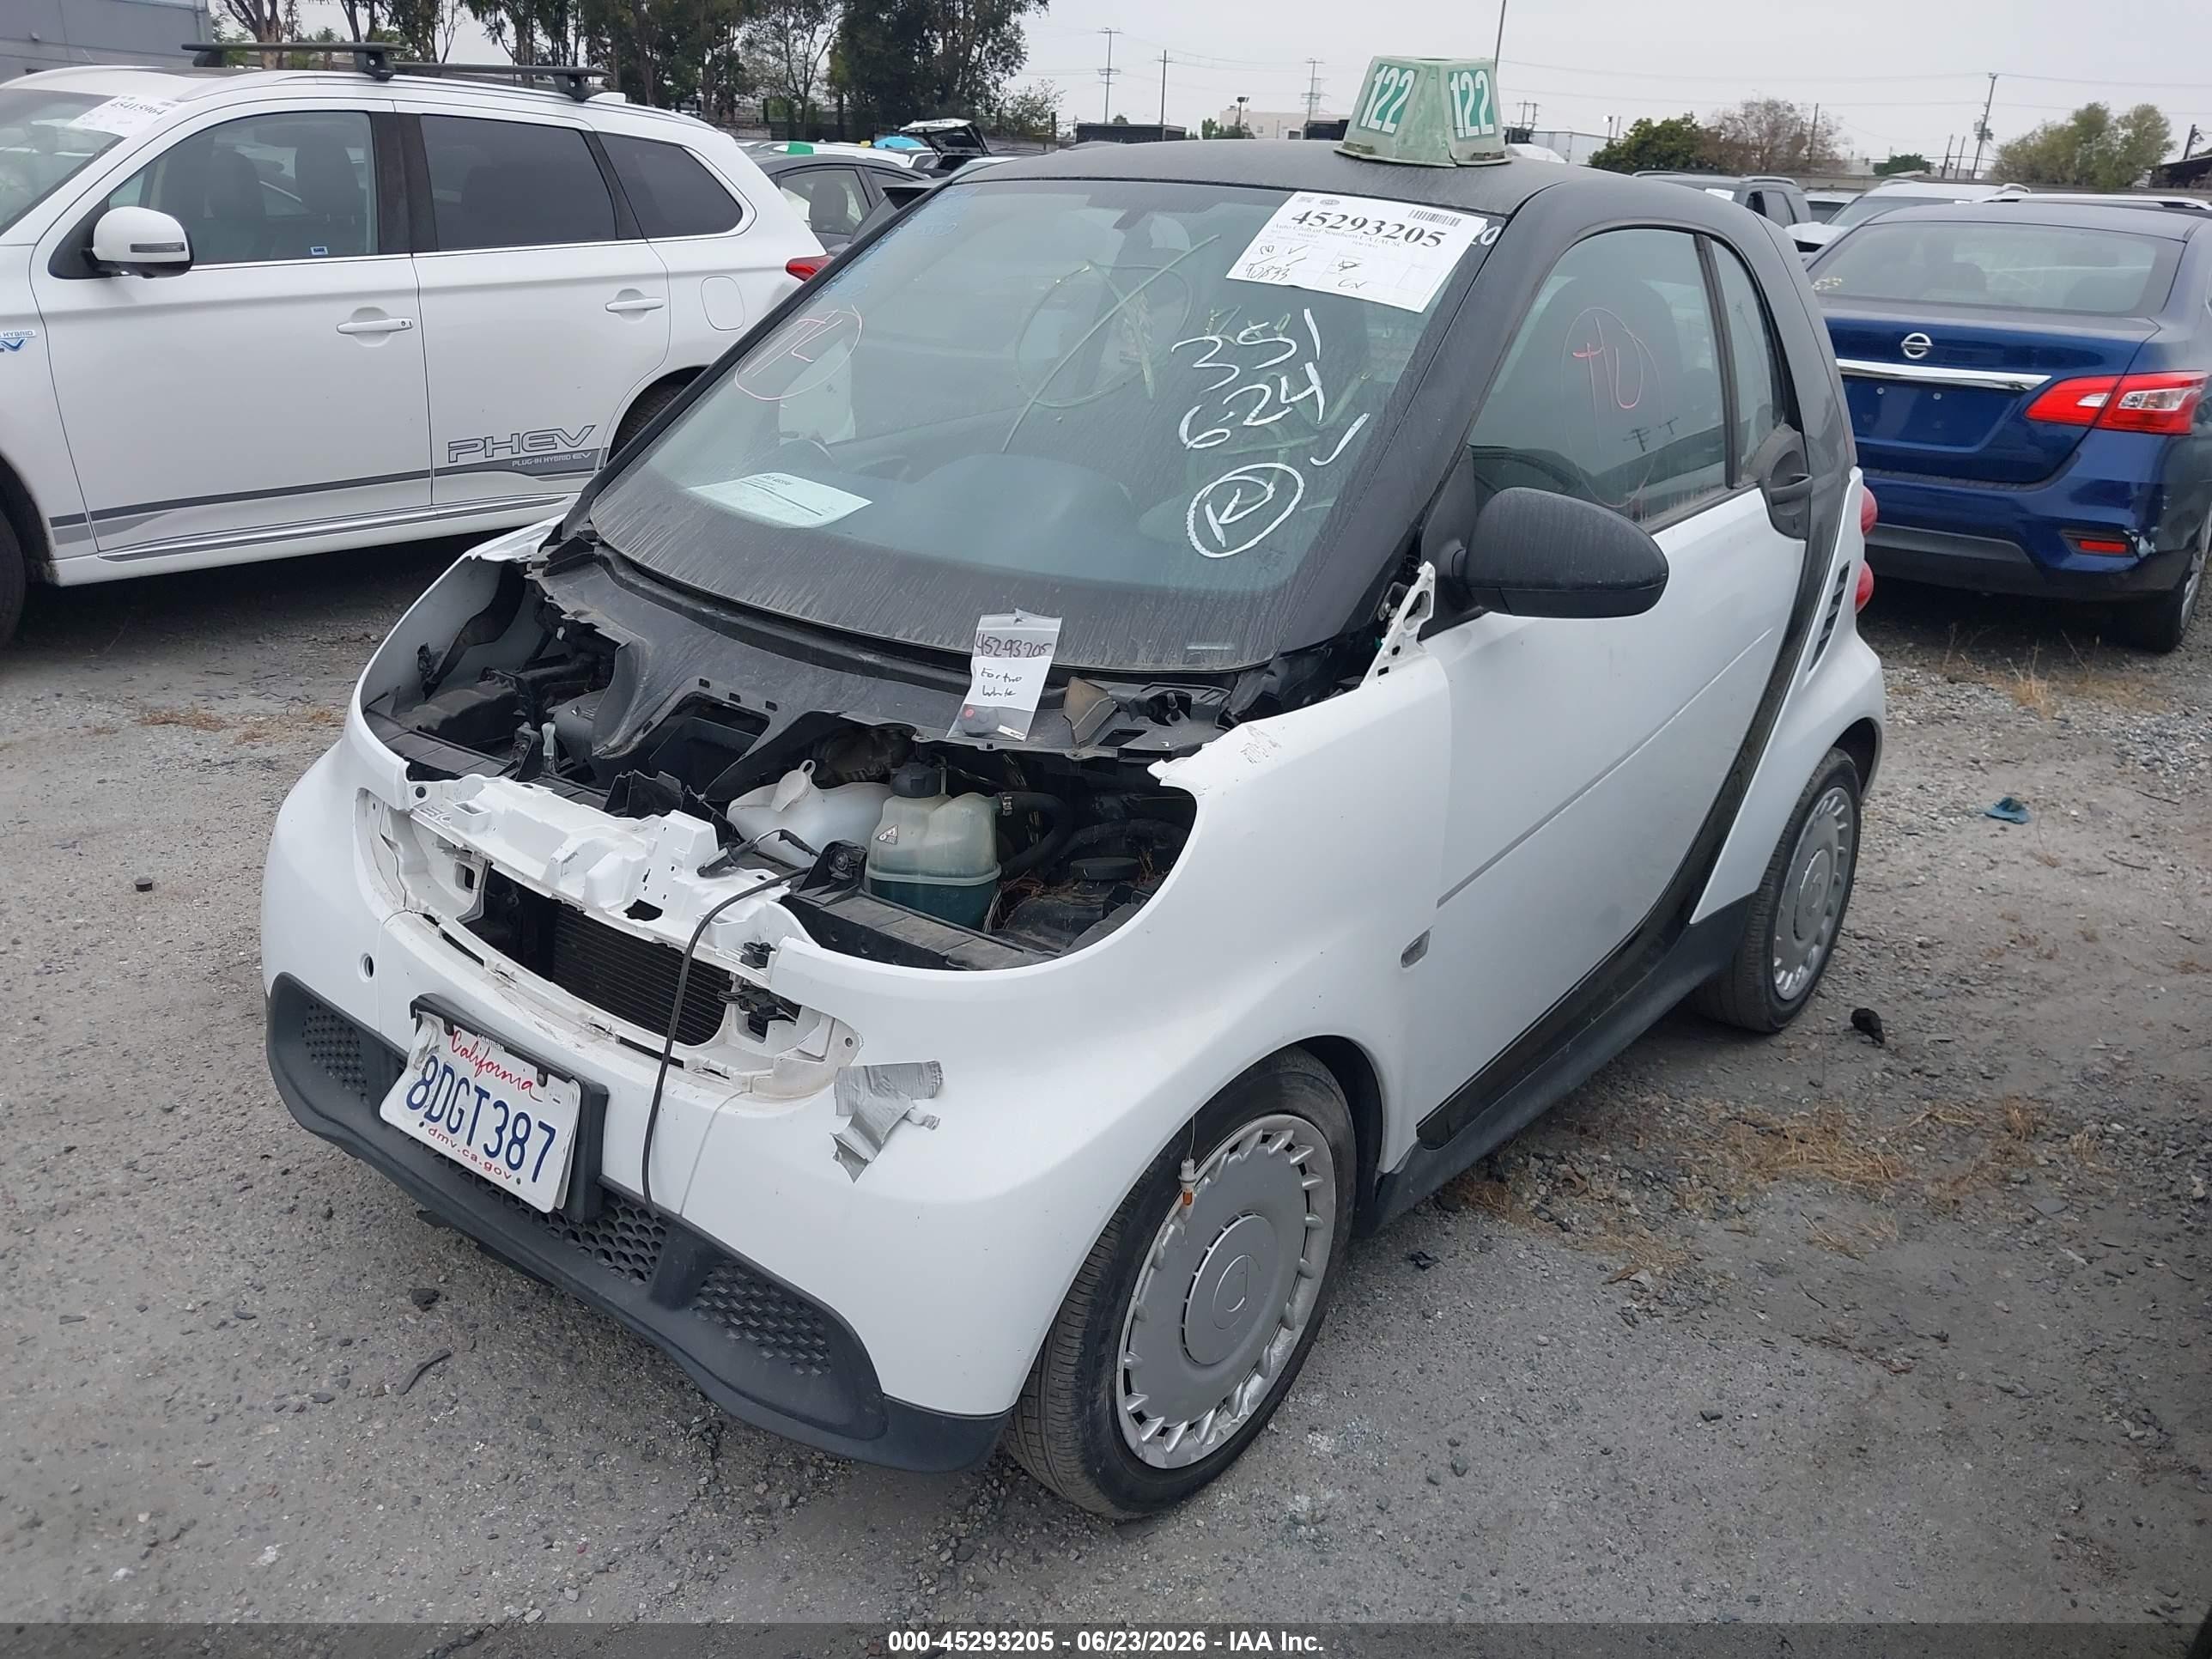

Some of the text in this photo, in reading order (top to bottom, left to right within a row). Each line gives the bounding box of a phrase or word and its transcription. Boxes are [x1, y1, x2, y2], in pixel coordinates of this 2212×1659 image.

[1360, 65, 1415, 134] 122
[1450, 70, 1495, 138] 122
[1291, 210, 1447, 248] 45293205
[448, 424, 597, 464] PHEV
[512, 452, 592, 467] PLUG-IN HYBRID EV
[450, 1030, 543, 1103] California
[406, 1055, 556, 1183] 8DGT387
[428, 1127, 512, 1180] dmv.ca.gov
